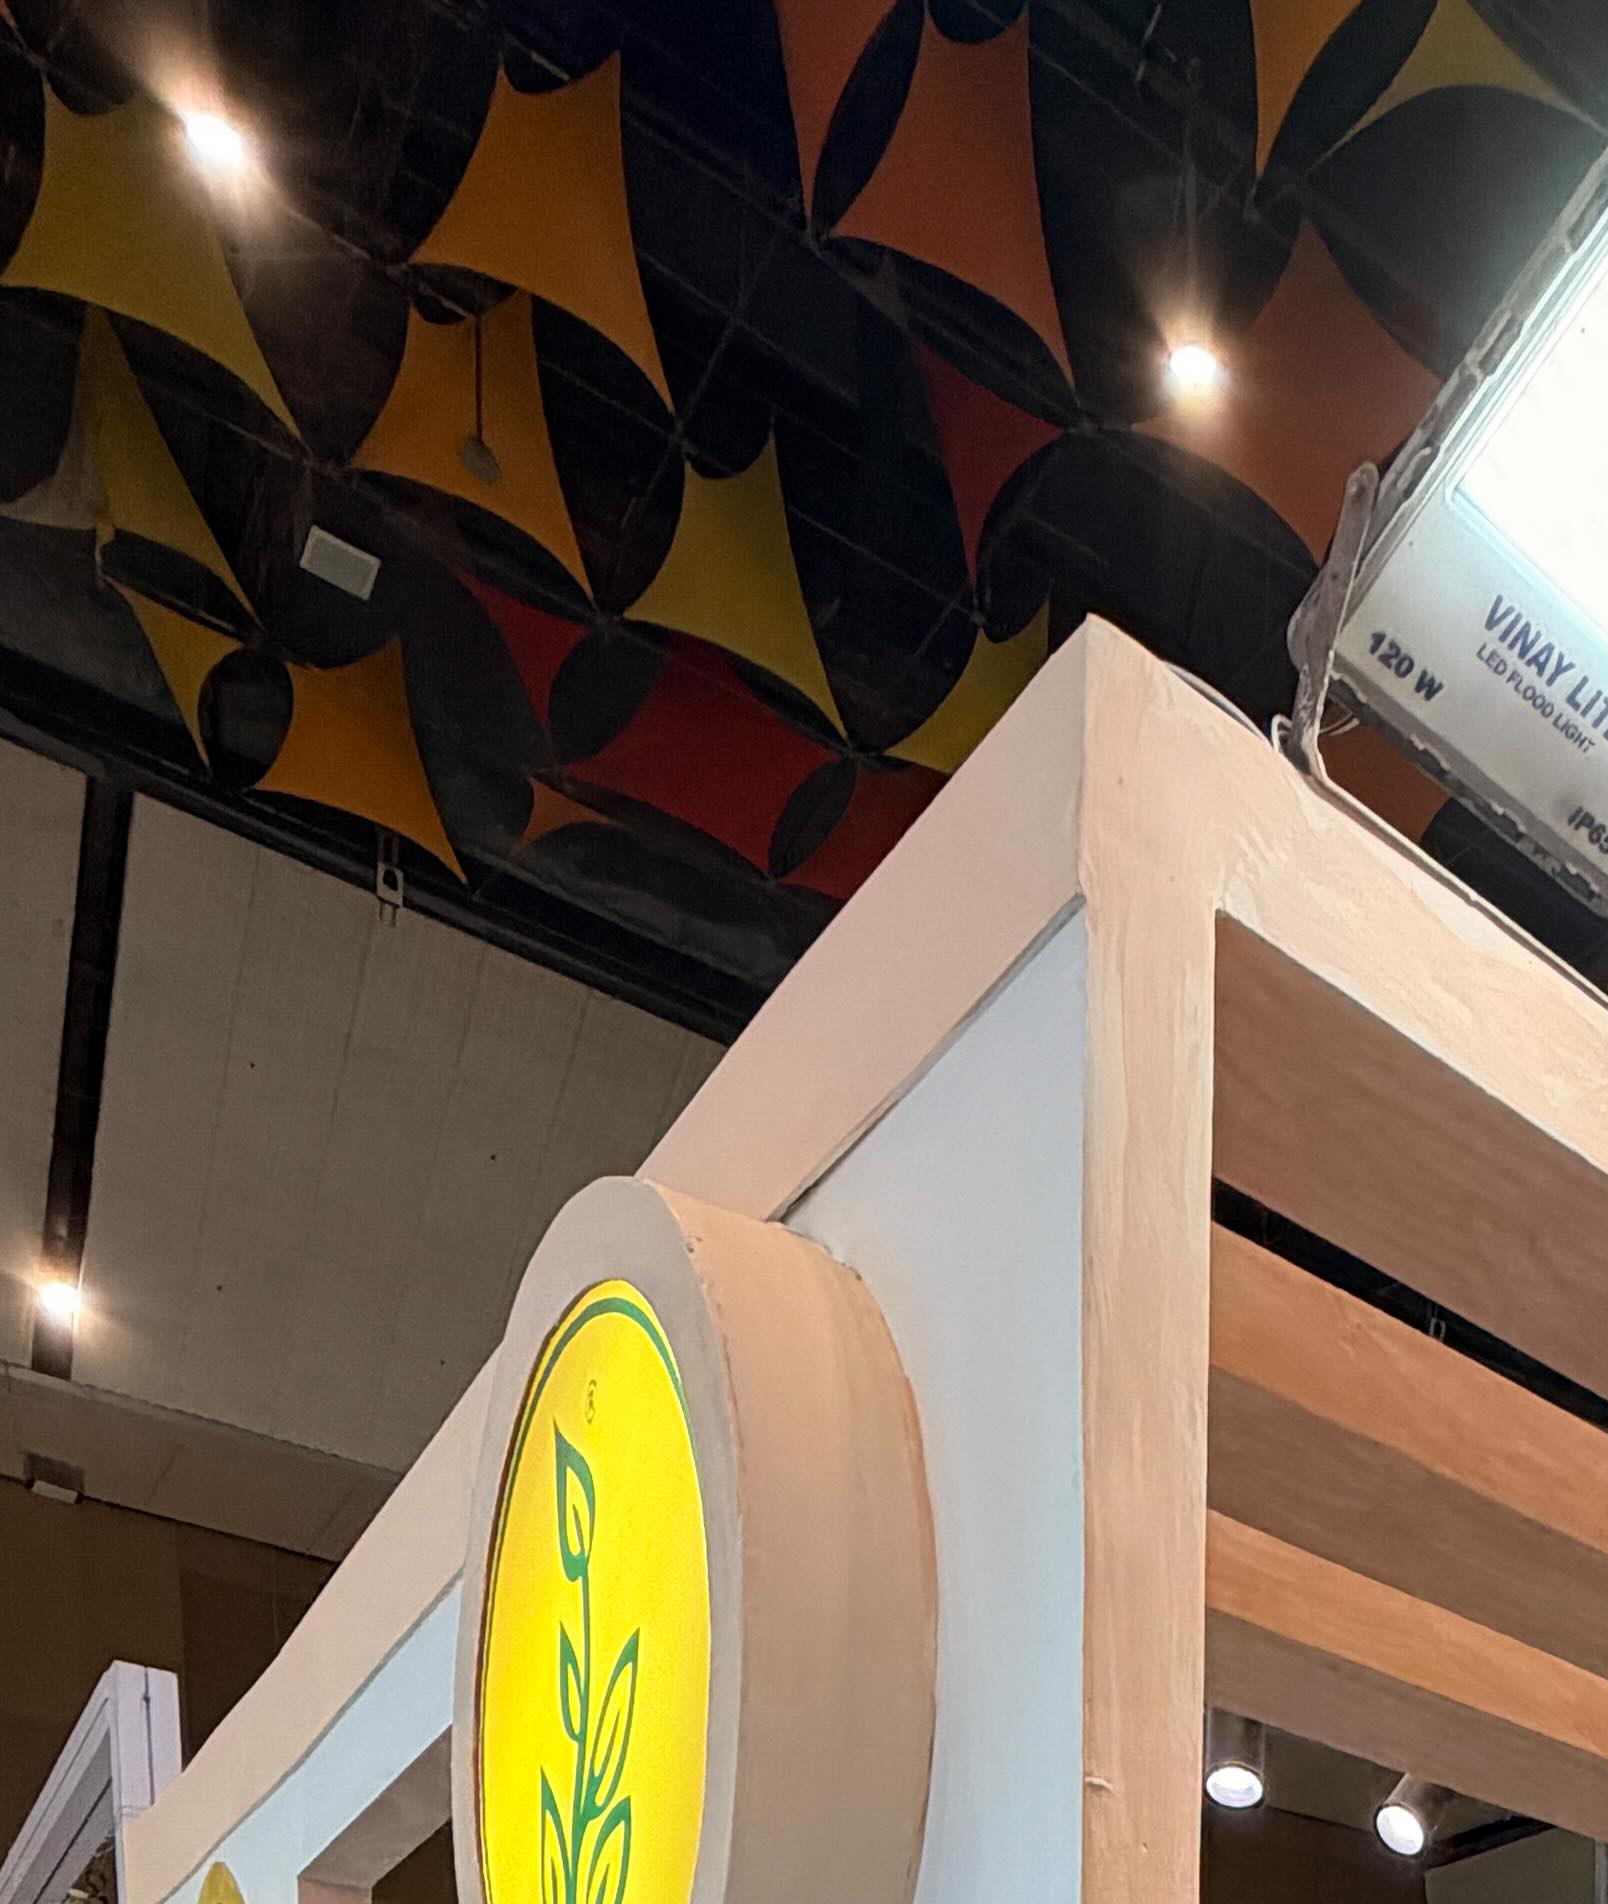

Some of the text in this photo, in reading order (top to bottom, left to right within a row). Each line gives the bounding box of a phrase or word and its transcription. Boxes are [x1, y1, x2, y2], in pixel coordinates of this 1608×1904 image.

[1369, 631, 1444, 702] 120 W
[1484, 594, 1576, 687] VINAY
[1476, 643, 1597, 753] LED FLOOD LIGHT
